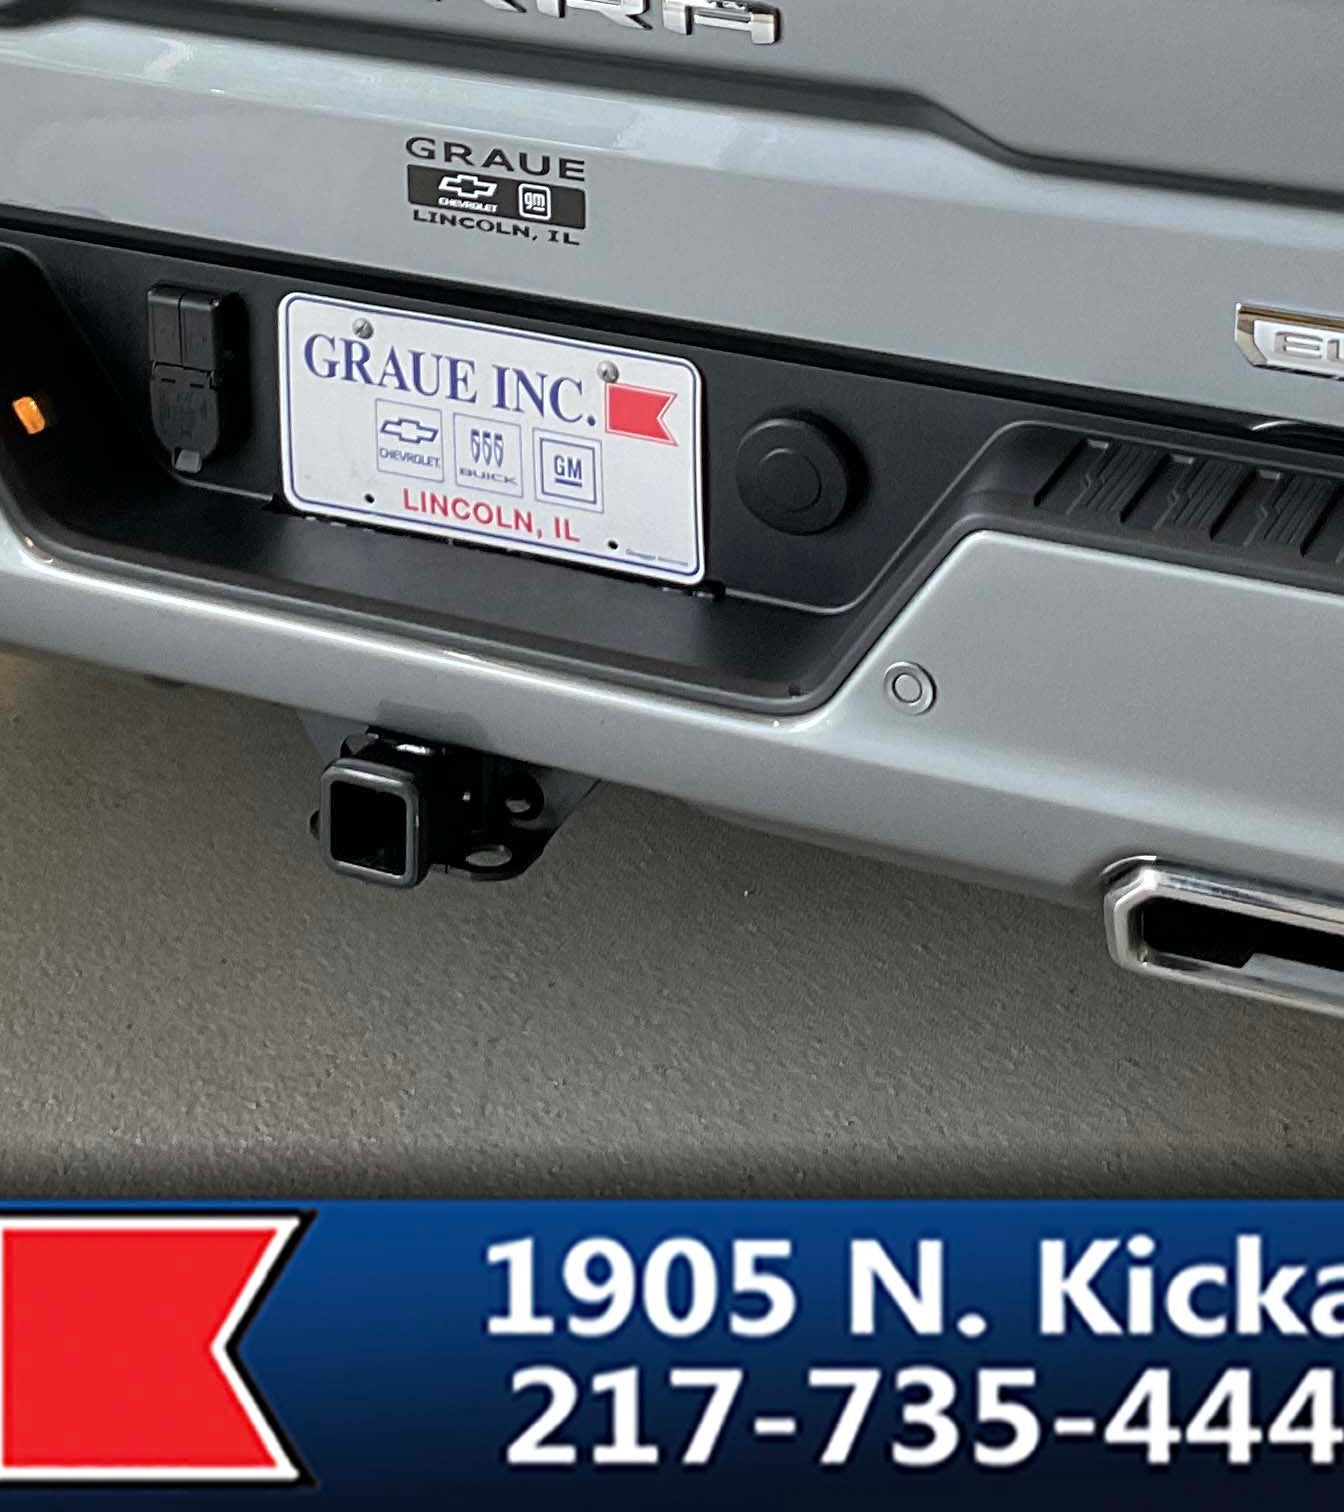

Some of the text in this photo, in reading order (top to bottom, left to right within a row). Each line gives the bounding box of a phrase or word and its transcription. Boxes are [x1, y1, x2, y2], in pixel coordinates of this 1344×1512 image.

[406, 136, 585, 182] GRAUE
[438, 196, 498, 213] CHEVROLET
[413, 209, 581, 246] LINCOLN, IL
[303, 333, 597, 427] GRAUE INC.
[379, 447, 440, 469] CHEVROLET
[554, 454, 583, 480] GM
[459, 467, 518, 486] BUICK
[402, 488, 581, 542] LINCOLN, IL
